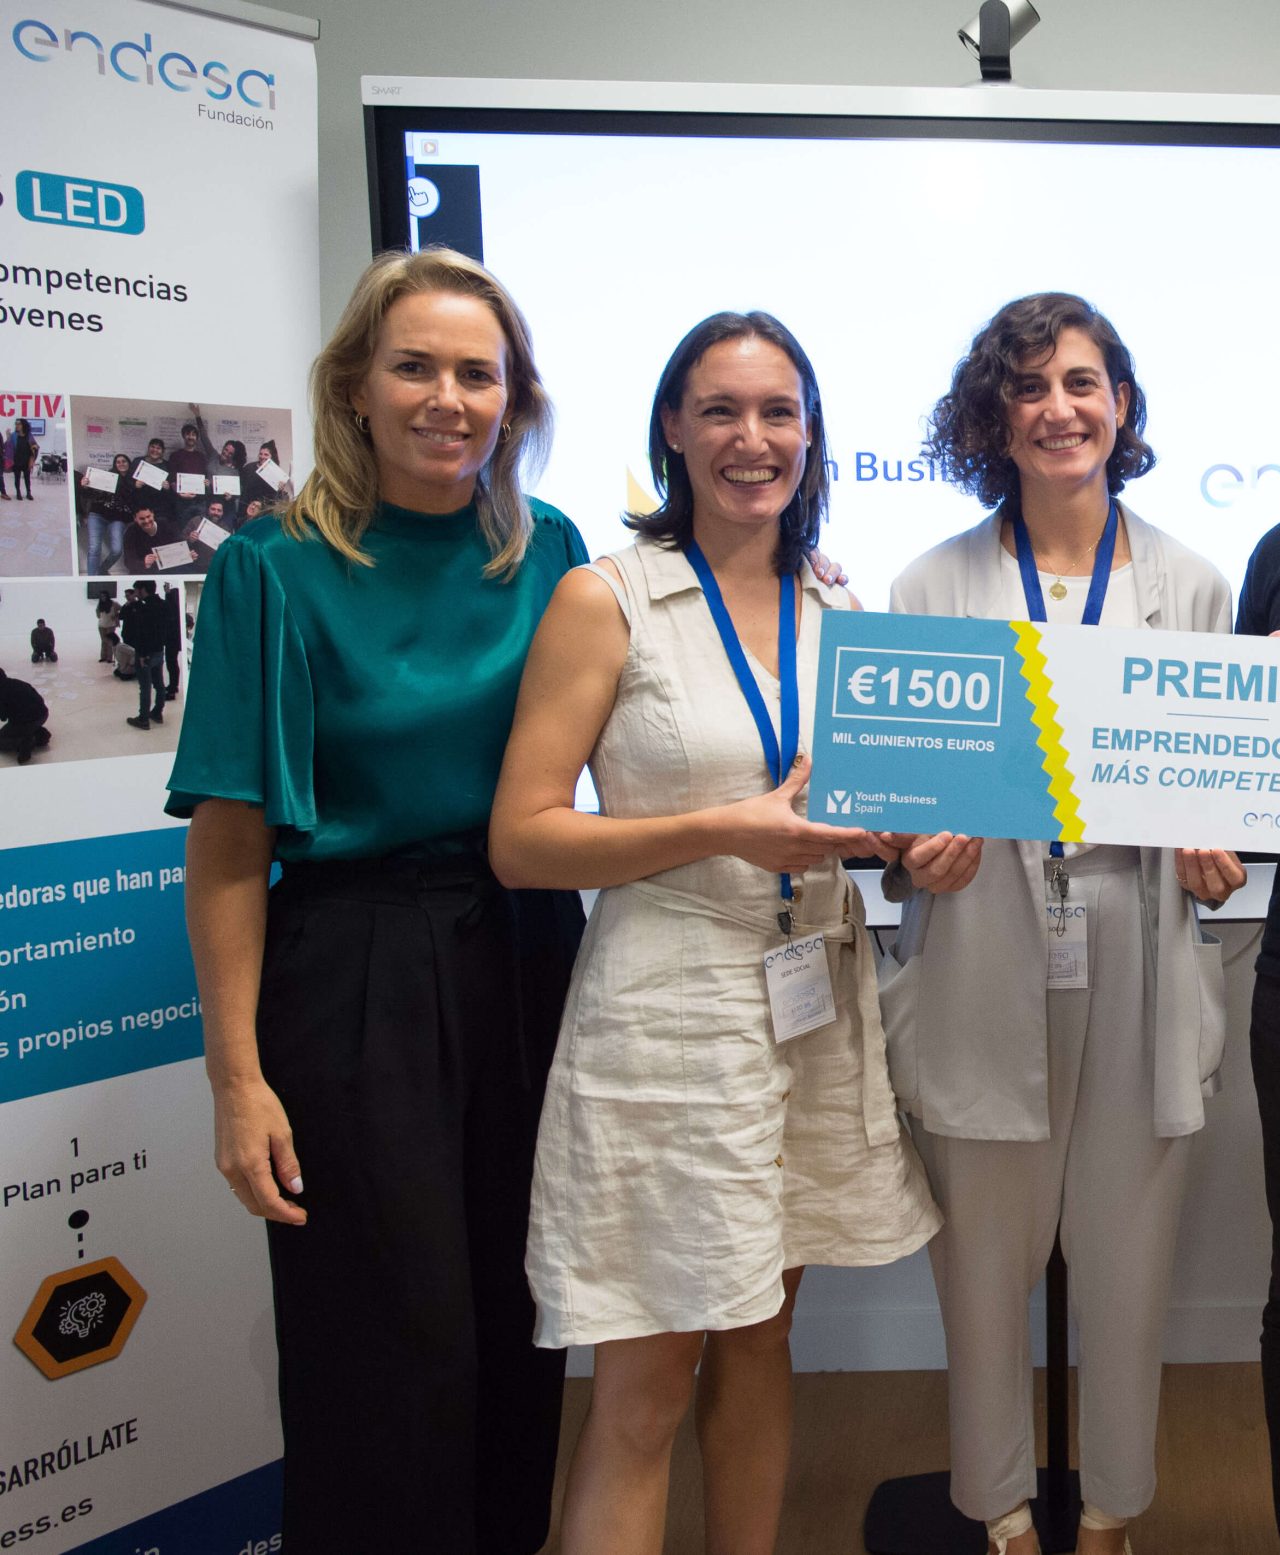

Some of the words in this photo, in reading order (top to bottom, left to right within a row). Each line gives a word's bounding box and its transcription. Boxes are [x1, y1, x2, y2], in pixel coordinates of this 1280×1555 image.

[12, 19, 276, 110] endesa
[198, 104, 274, 131] Fundación
[32, 177, 128, 228] LED
[0, 394, 65, 418] CTIV
[856, 452, 947, 481] Busi
[847, 665, 990, 711] €1500
[832, 732, 856, 744] MIL
[859, 733, 943, 749] QUINIENTOS
[947, 740, 995, 752] EUROS
[1091, 759, 1150, 785] MÁS
[854, 803, 883, 814] Spain
[855, 791, 886, 803] Youth
[889, 793, 937, 805] Business
[73, 880, 110, 904] que
[116, 869, 153, 892] han
[0, 927, 136, 967] ortamiento
[18, 1019, 113, 1059] propios
[70, 1137, 79, 1158] 1
[4, 1177, 61, 1207] Plan
[71, 1162, 125, 1193] para
[133, 1149, 148, 1171] ti
[1, 1498, 93, 1548] ess.es
